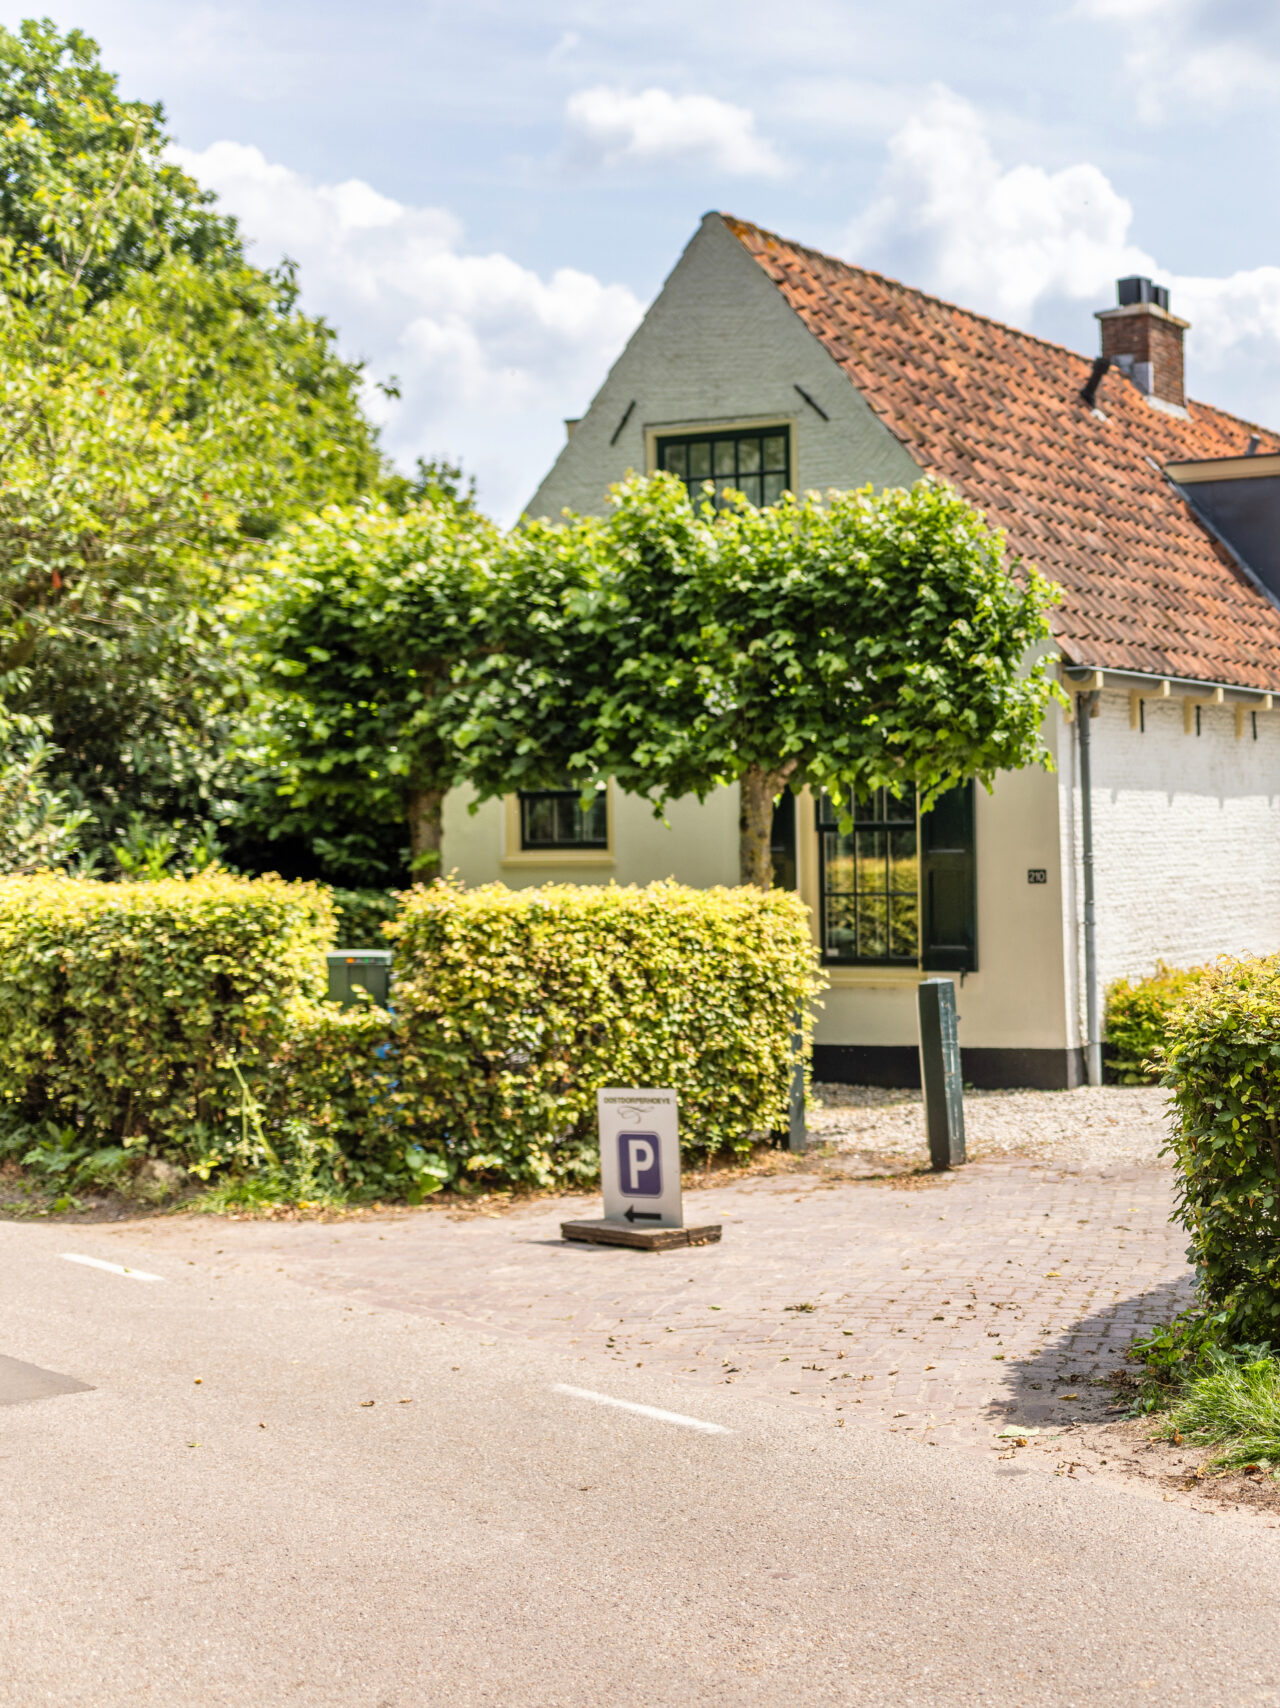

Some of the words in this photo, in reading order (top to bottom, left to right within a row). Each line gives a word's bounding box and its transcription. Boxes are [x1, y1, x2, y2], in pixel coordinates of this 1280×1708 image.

[1028, 871, 1045, 882] 210
[603, 1097, 670, 1105] OOSTDORPERHOEVE
[628, 1139, 655, 1189] P
